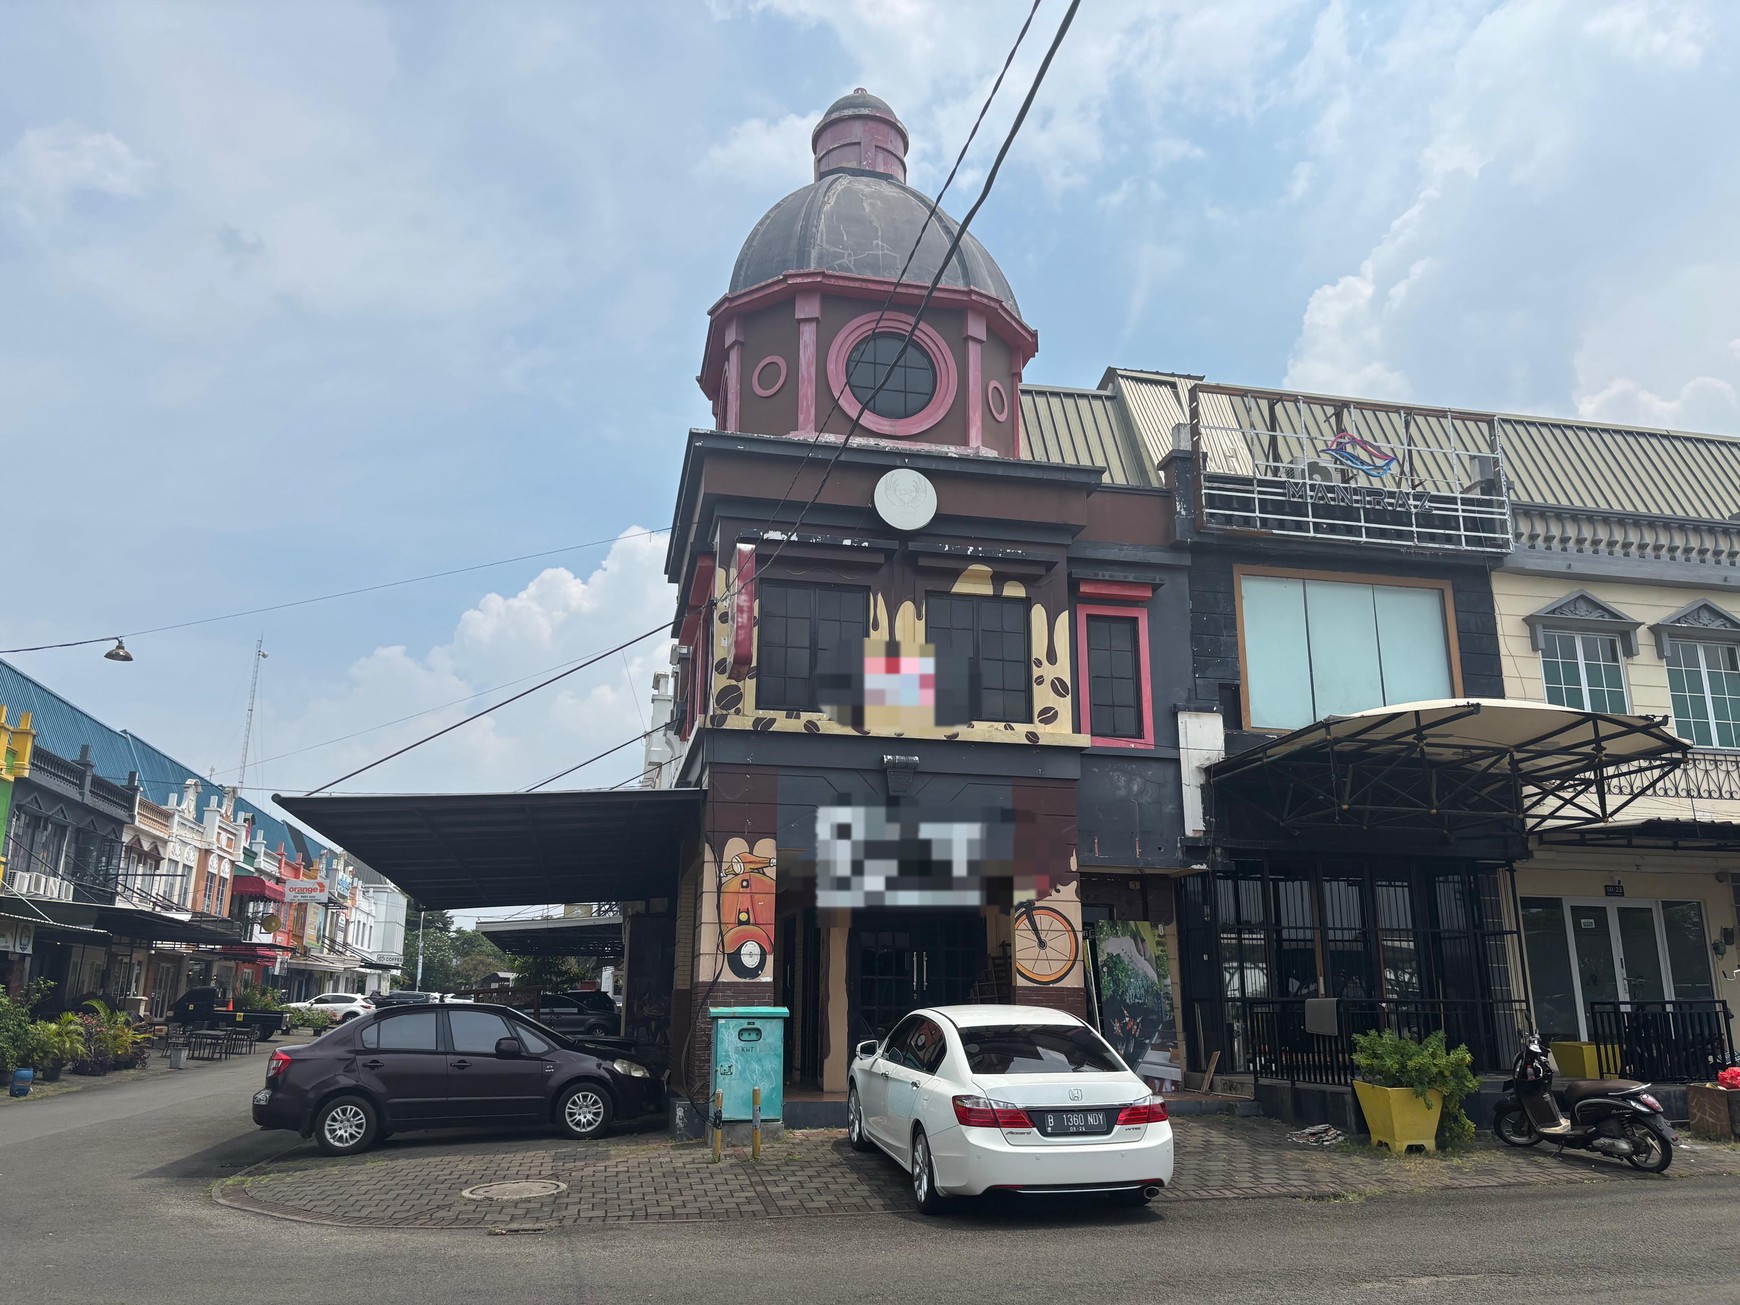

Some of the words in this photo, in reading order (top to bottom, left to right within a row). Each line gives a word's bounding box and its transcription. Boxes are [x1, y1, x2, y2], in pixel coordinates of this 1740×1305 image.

[1285, 480, 1434, 513] MANTRAZ
[289, 886, 318, 894] orange
[1047, 1114, 1055, 1127] B
[1063, 1114, 1085, 1126] 1360
[1088, 1113, 1104, 1125] NDY
